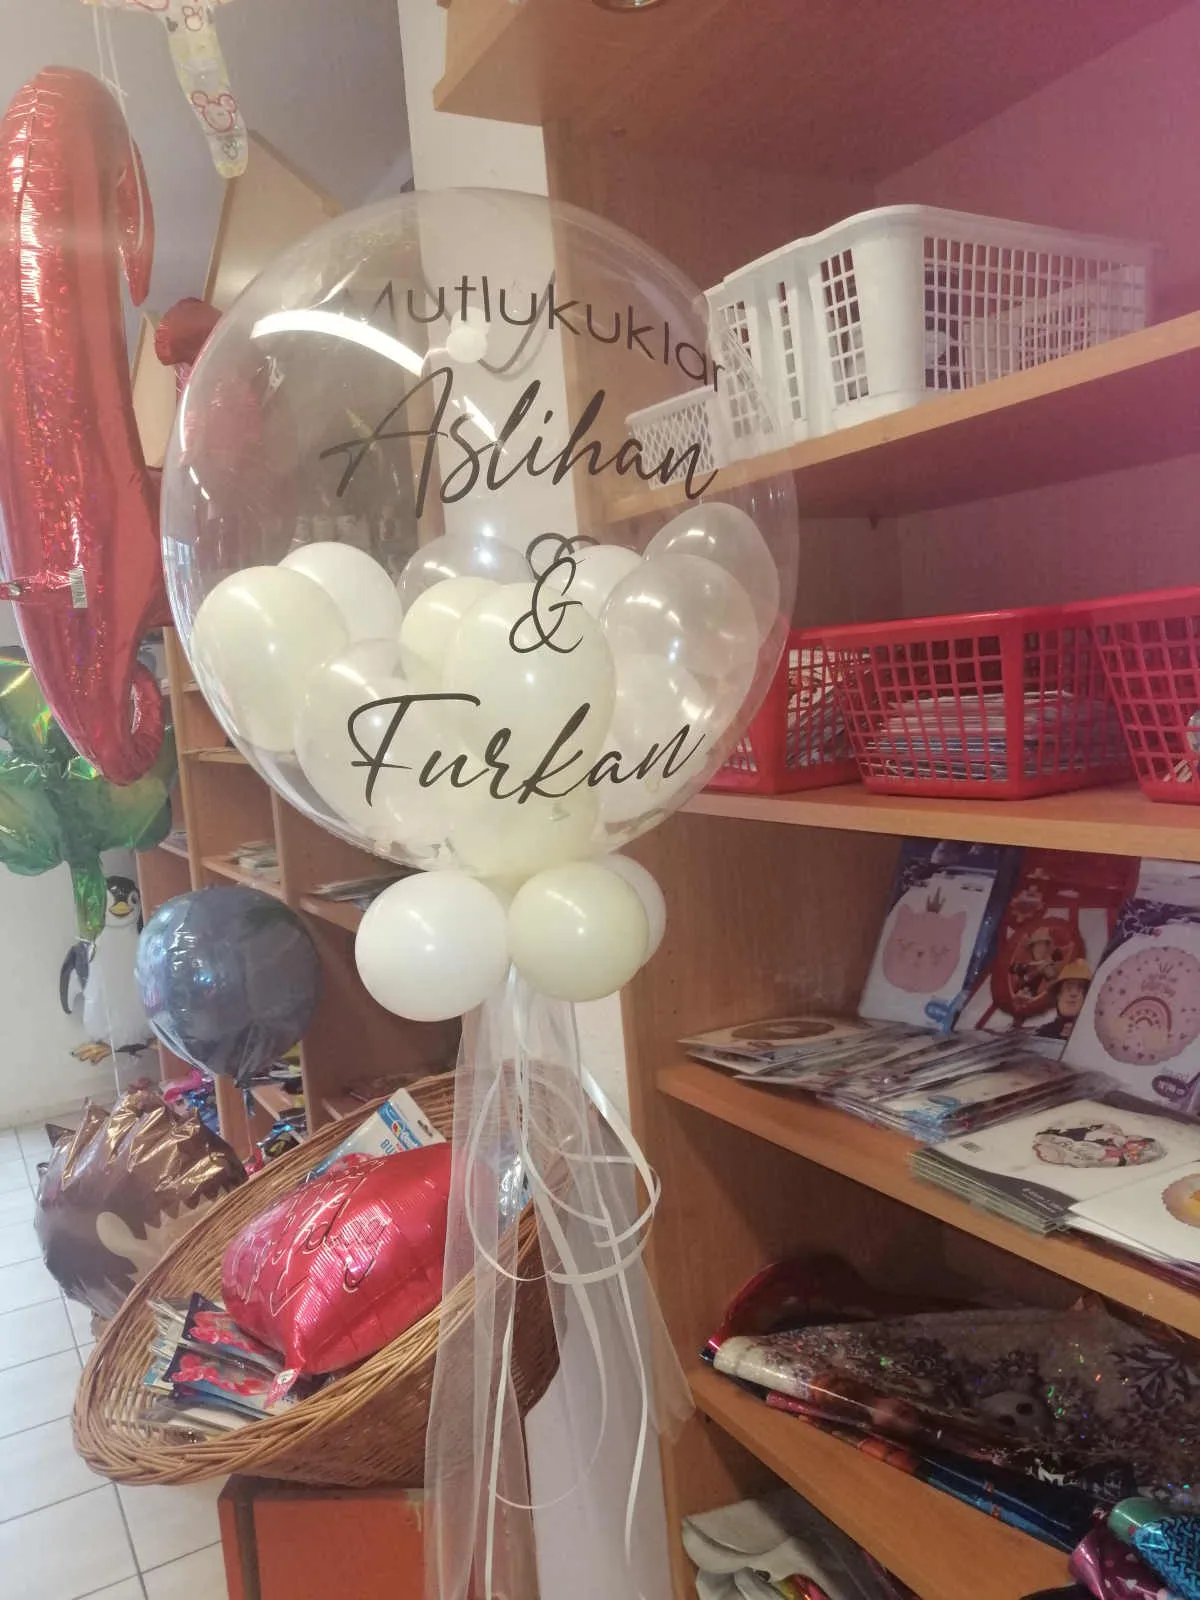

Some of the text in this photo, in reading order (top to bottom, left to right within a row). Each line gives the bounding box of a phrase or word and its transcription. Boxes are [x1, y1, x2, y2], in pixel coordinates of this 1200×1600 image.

[319, 366, 719, 519] Aslihan
[508, 556, 583, 653] &
[347, 692, 706, 807] Furkan
